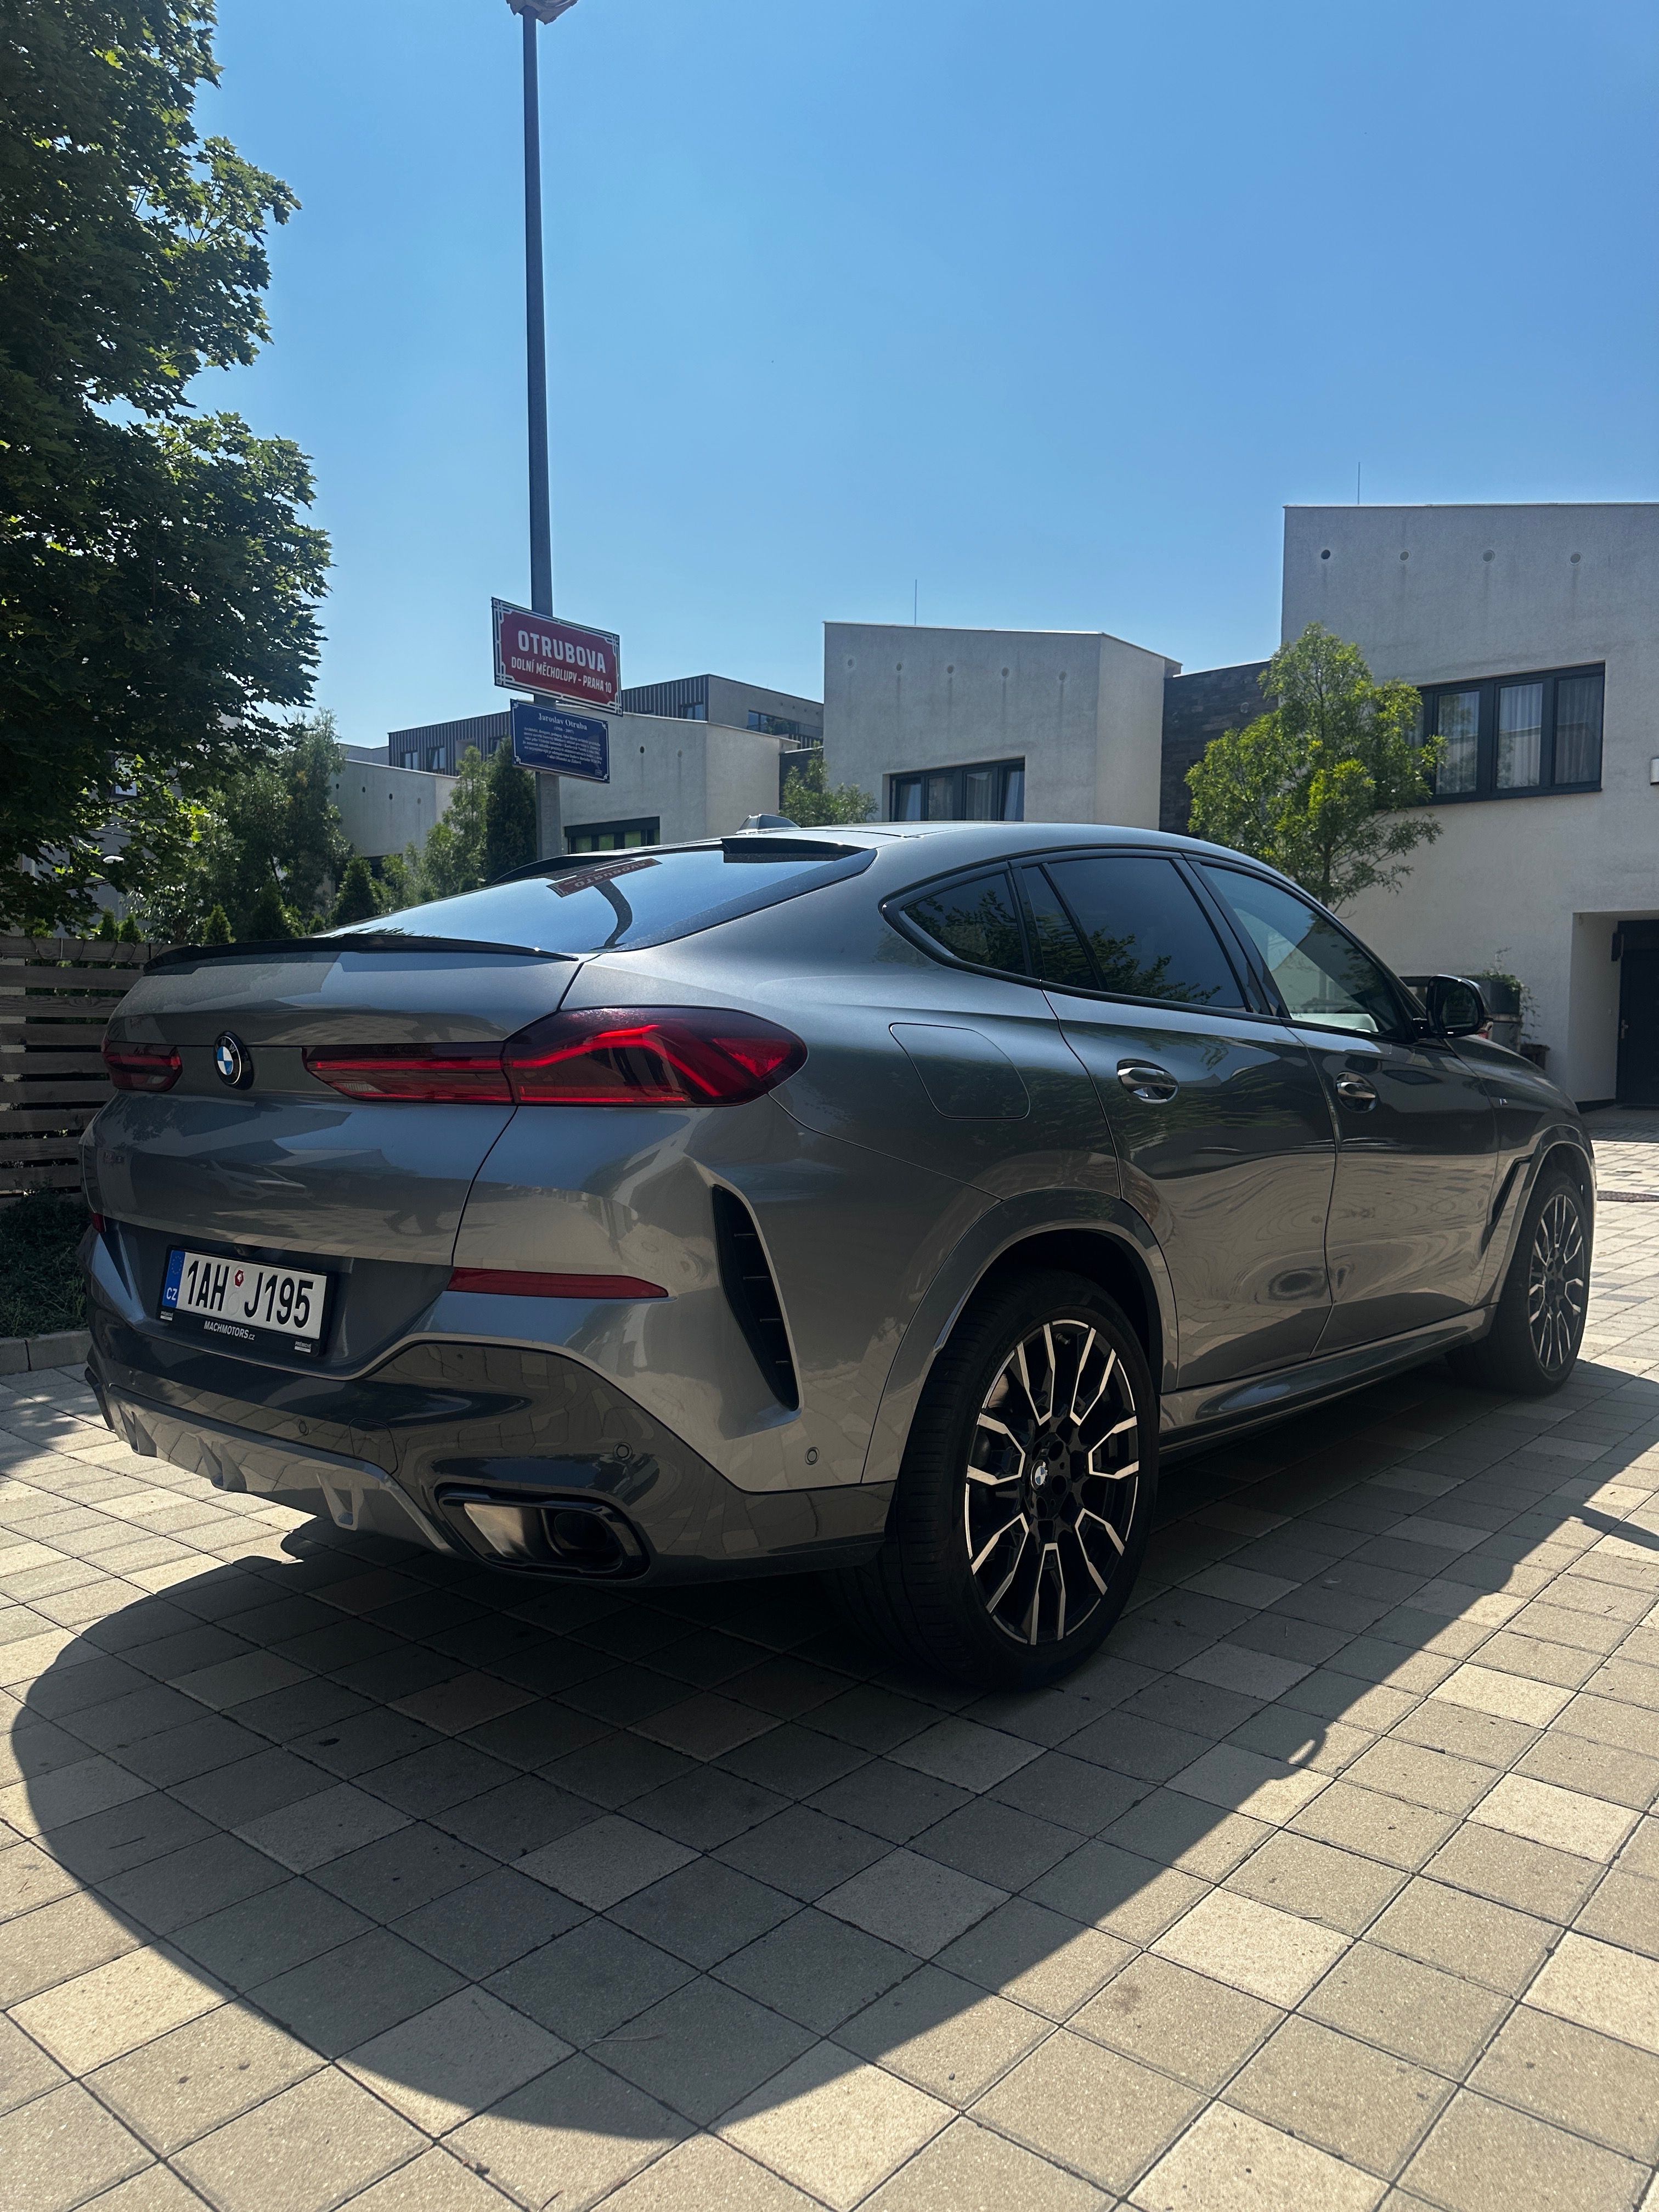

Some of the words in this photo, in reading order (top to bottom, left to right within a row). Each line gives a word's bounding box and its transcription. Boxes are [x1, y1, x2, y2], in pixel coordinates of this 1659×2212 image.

[518, 630, 606, 673] OTRUBOVA
[511, 656, 534, 673] DOLNÍ
[537, 661, 577, 684] MĚCHOLUPY
[583, 675, 604, 691] PRAHA
[605, 681, 612, 693] 10
[538, 713, 564, 725] Jaroslav
[565, 719, 588, 730] Otruba
[166, 1287, 177, 1301] CZ
[188, 1261, 229, 1311] 1AH
[244, 1272, 313, 1328] J195
[204, 1321, 255, 1341] MACHMOTORS.cz
